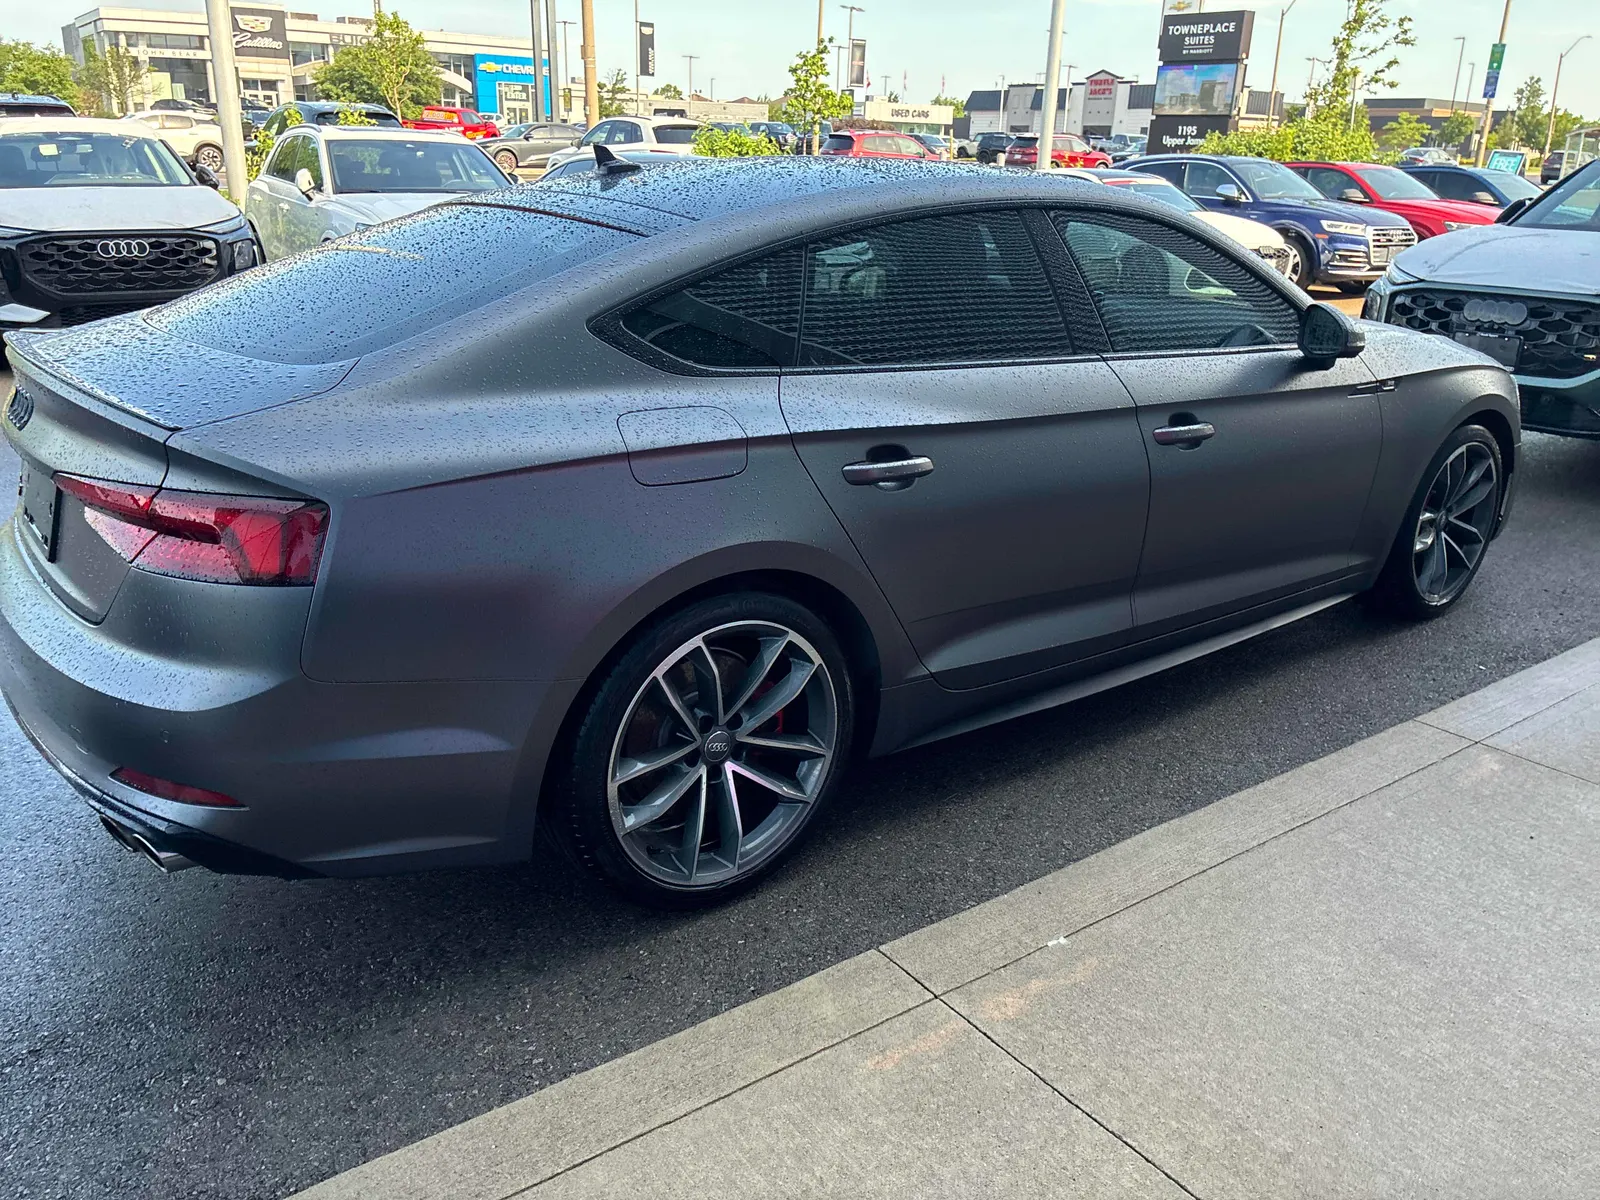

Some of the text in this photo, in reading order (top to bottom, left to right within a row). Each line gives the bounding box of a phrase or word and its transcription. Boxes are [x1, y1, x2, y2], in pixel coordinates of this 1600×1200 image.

[1168, 22, 1236, 35] TOWNEPLACE
[232, 32, 283, 50] Cadillac
[329, 33, 377, 46] BUIC
[1184, 36, 1215, 45] SUITES
[891, 109, 930, 118] USED CARS
[1178, 126, 1197, 136] 1195
[1162, 136, 1185, 148] Upper
